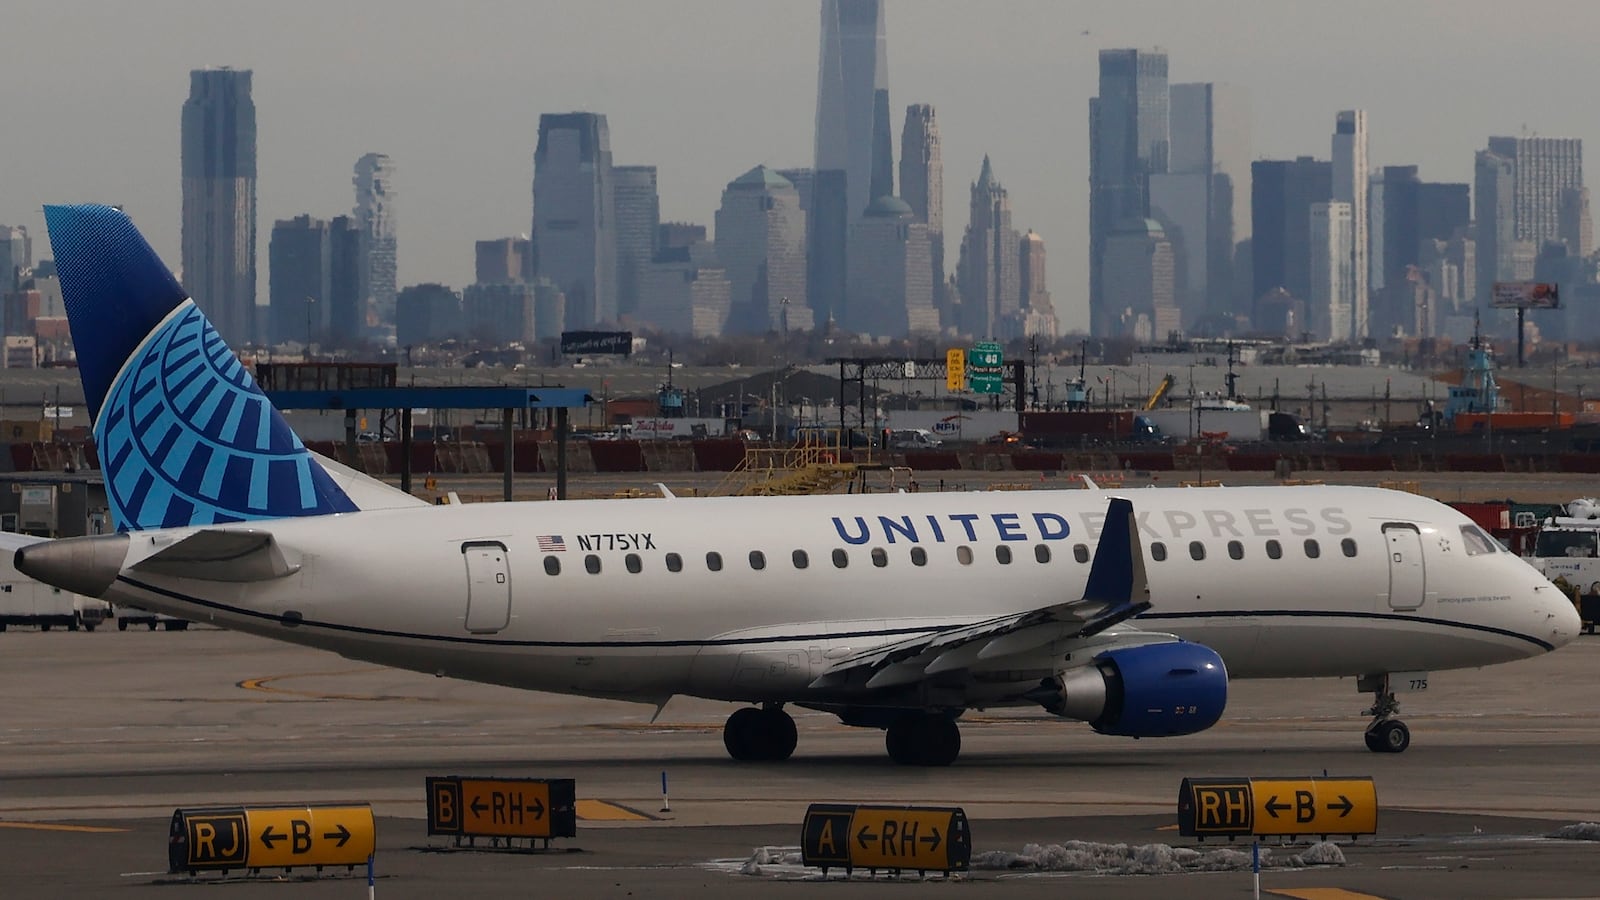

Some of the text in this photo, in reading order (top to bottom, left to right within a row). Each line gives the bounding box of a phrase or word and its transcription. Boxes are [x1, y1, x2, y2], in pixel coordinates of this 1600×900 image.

[576, 533, 656, 551] N775YX
[831, 513, 1070, 545] UNITED
[1410, 679, 1428, 690] 775
[438, 789, 523, 825] B RH
[1200, 790, 1316, 825] RH B
[195, 819, 312, 859] RJ B
[818, 818, 919, 857] A RH
